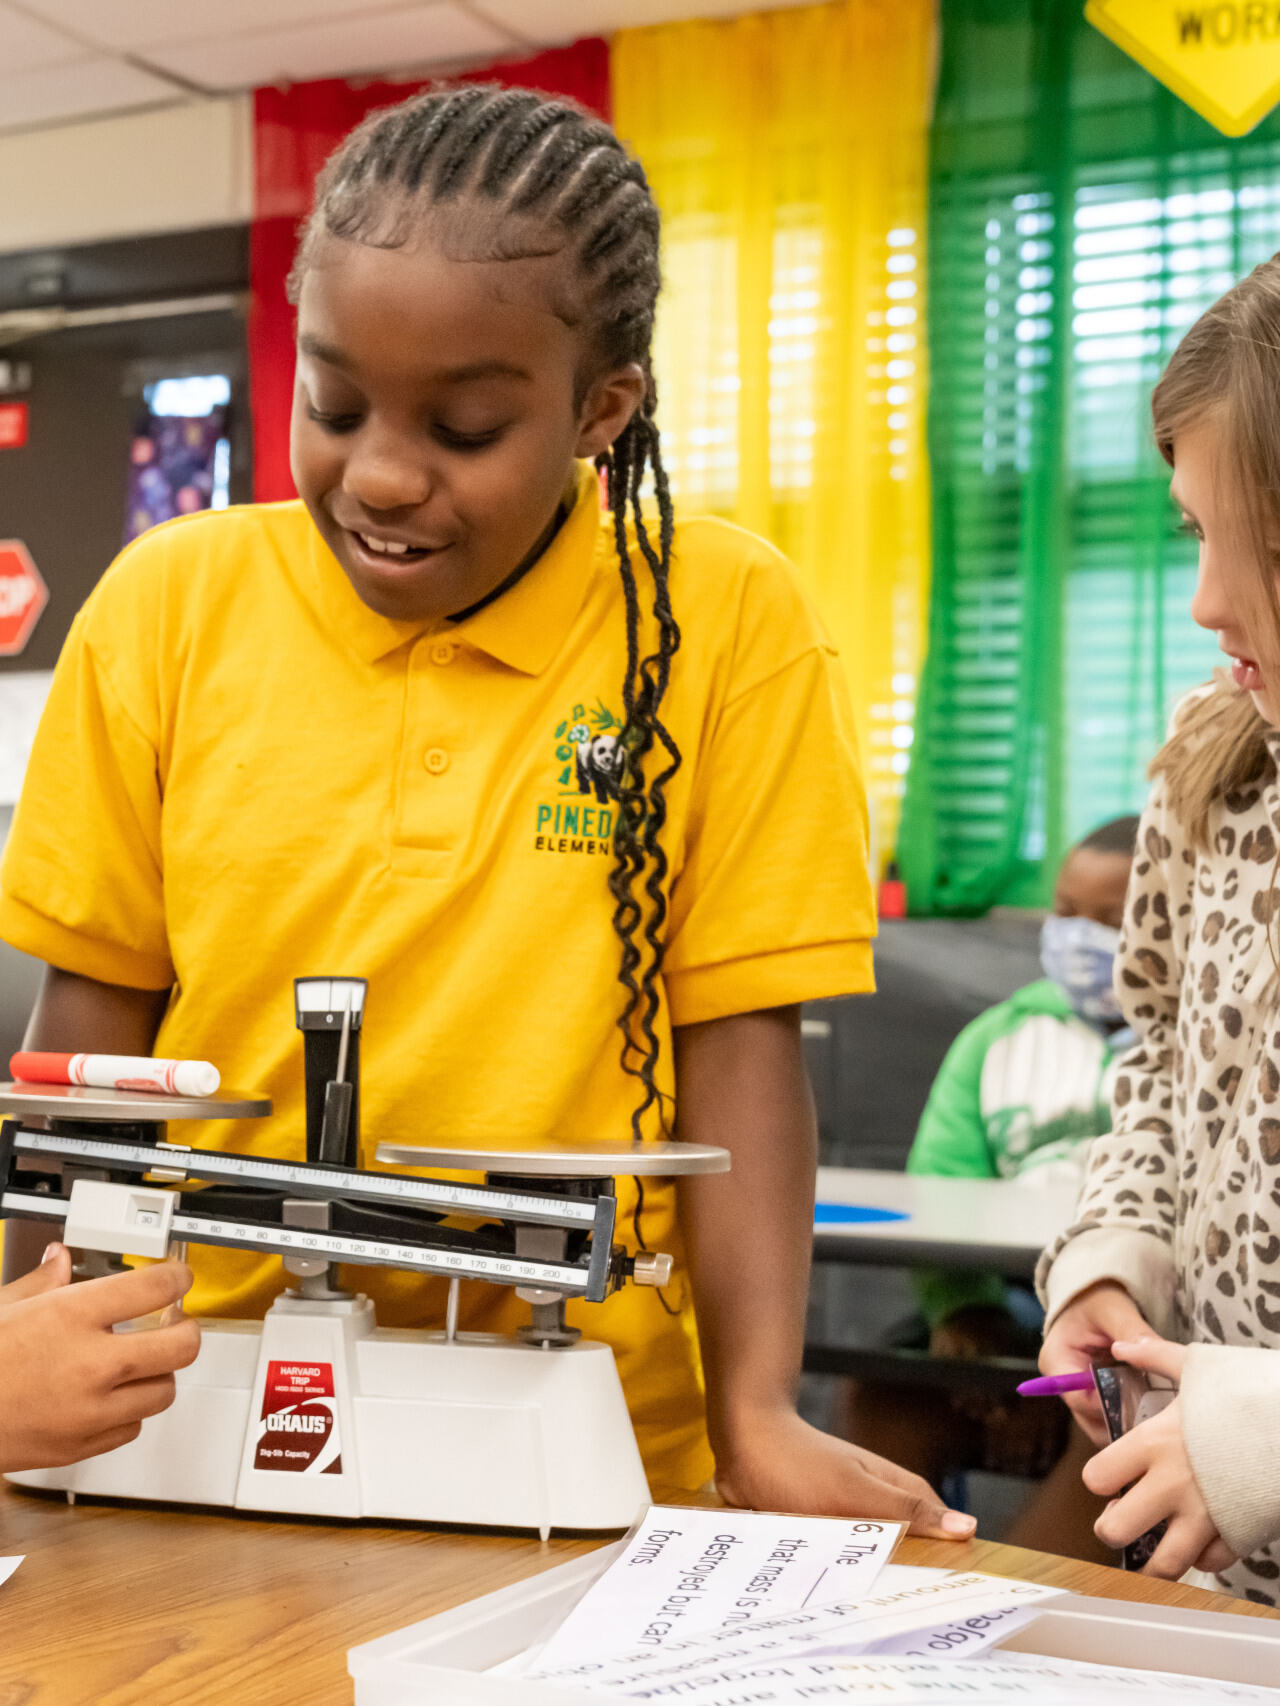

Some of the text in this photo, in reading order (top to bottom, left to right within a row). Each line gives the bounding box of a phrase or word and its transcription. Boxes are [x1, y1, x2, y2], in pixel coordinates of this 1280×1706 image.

[1174, 4, 1280, 47] WOR
[326, 1014, 334, 1024] 0
[141, 1215, 153, 1225] 30
[187, 1222, 199, 1231] 50
[210, 1225, 222, 1234] 60
[235, 1228, 247, 1237] 70
[257, 1231, 269, 1240] 80
[280, 1234, 292, 1243] 90
[302, 1237, 318, 1247] 100
[326, 1240, 342, 1250] 110
[350, 1243, 366, 1253] 120
[374, 1247, 390, 1257] 130
[398, 1250, 414, 1259] 140
[421, 1253, 437, 1262] 150
[446, 1256, 462, 1266] 160
[471, 1260, 487, 1269] 170
[495, 1263, 511, 1273] 180
[520, 1266, 535, 1276] 190
[542, 1269, 561, 1279] 200
[280, 1366, 321, 1377] HARVARD
[290, 1376, 310, 1385] TRIP
[267, 1414, 325, 1433] OHAUS
[284, 1449, 310, 1460] Capacity
[628, 1529, 683, 1567] forms.
[766, 1538, 809, 1564] that
[835, 1523, 884, 1566] 6. The
[745, 1565, 785, 1593] mass
[637, 1534, 744, 1645] destroyed but can
[862, 1576, 987, 1606] amount
[735, 1597, 772, 1608] is
[824, 1603, 859, 1617] of
[710, 1614, 818, 1641] matter
[662, 1639, 708, 1652] in
[612, 1652, 658, 1664] an
[601, 1648, 752, 1687] measure
[809, 1663, 941, 1675] added
[794, 1680, 896, 1698] total
